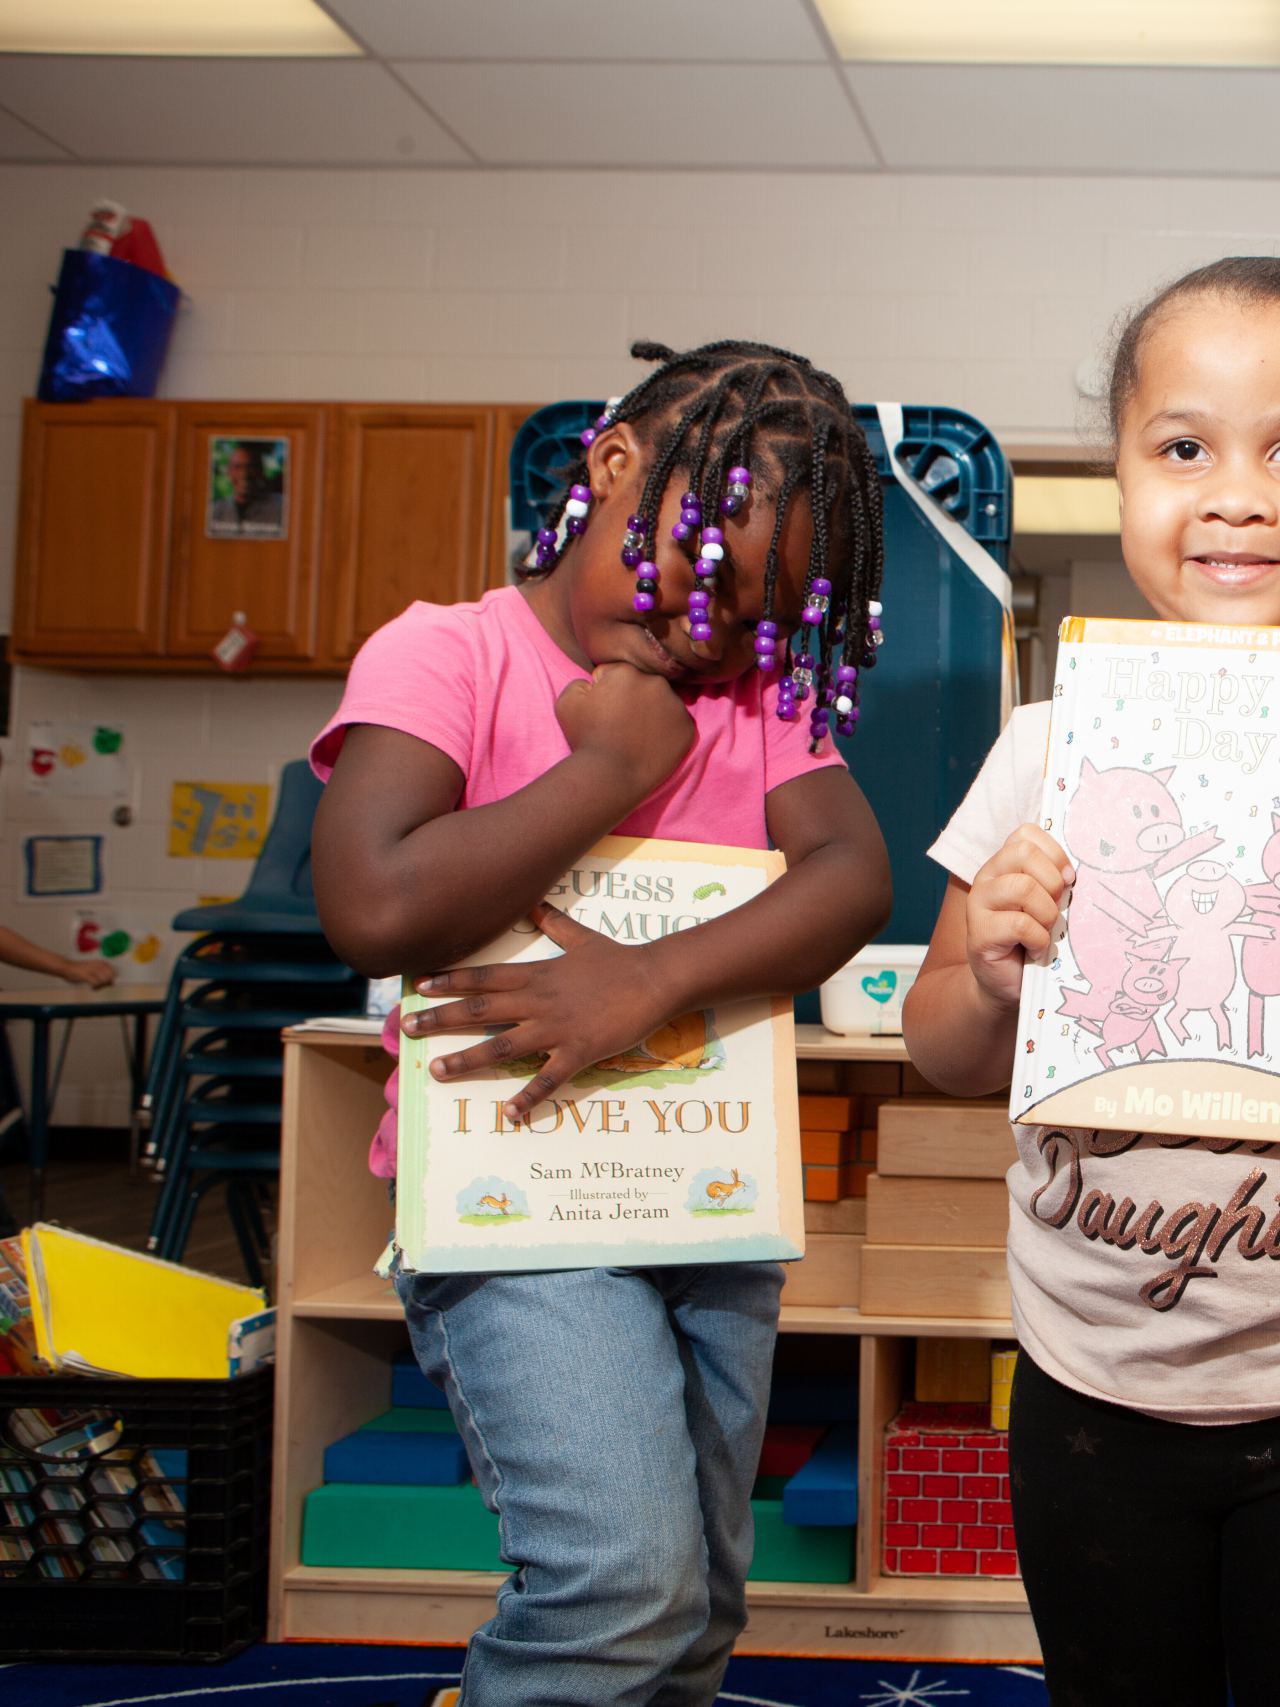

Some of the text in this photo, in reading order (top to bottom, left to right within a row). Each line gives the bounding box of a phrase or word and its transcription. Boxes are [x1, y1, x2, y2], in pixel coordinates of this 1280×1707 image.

[1165, 627, 1255, 645] ELEPHANT
[1257, 632, 1268, 646] &
[1102, 657, 1274, 716] Happy
[599, 911, 714, 942] MUC
[1094, 1096, 1117, 1118] By
[1125, 1086, 1174, 1116] Mo
[453, 1098, 752, 1135] I LOVE YOU
[530, 1162, 685, 1183] Sam McBratney
[569, 1188, 649, 1202] Illustrated by
[549, 1203, 670, 1221] Anita Jeram
[825, 1626, 899, 1639] Lakeshore
